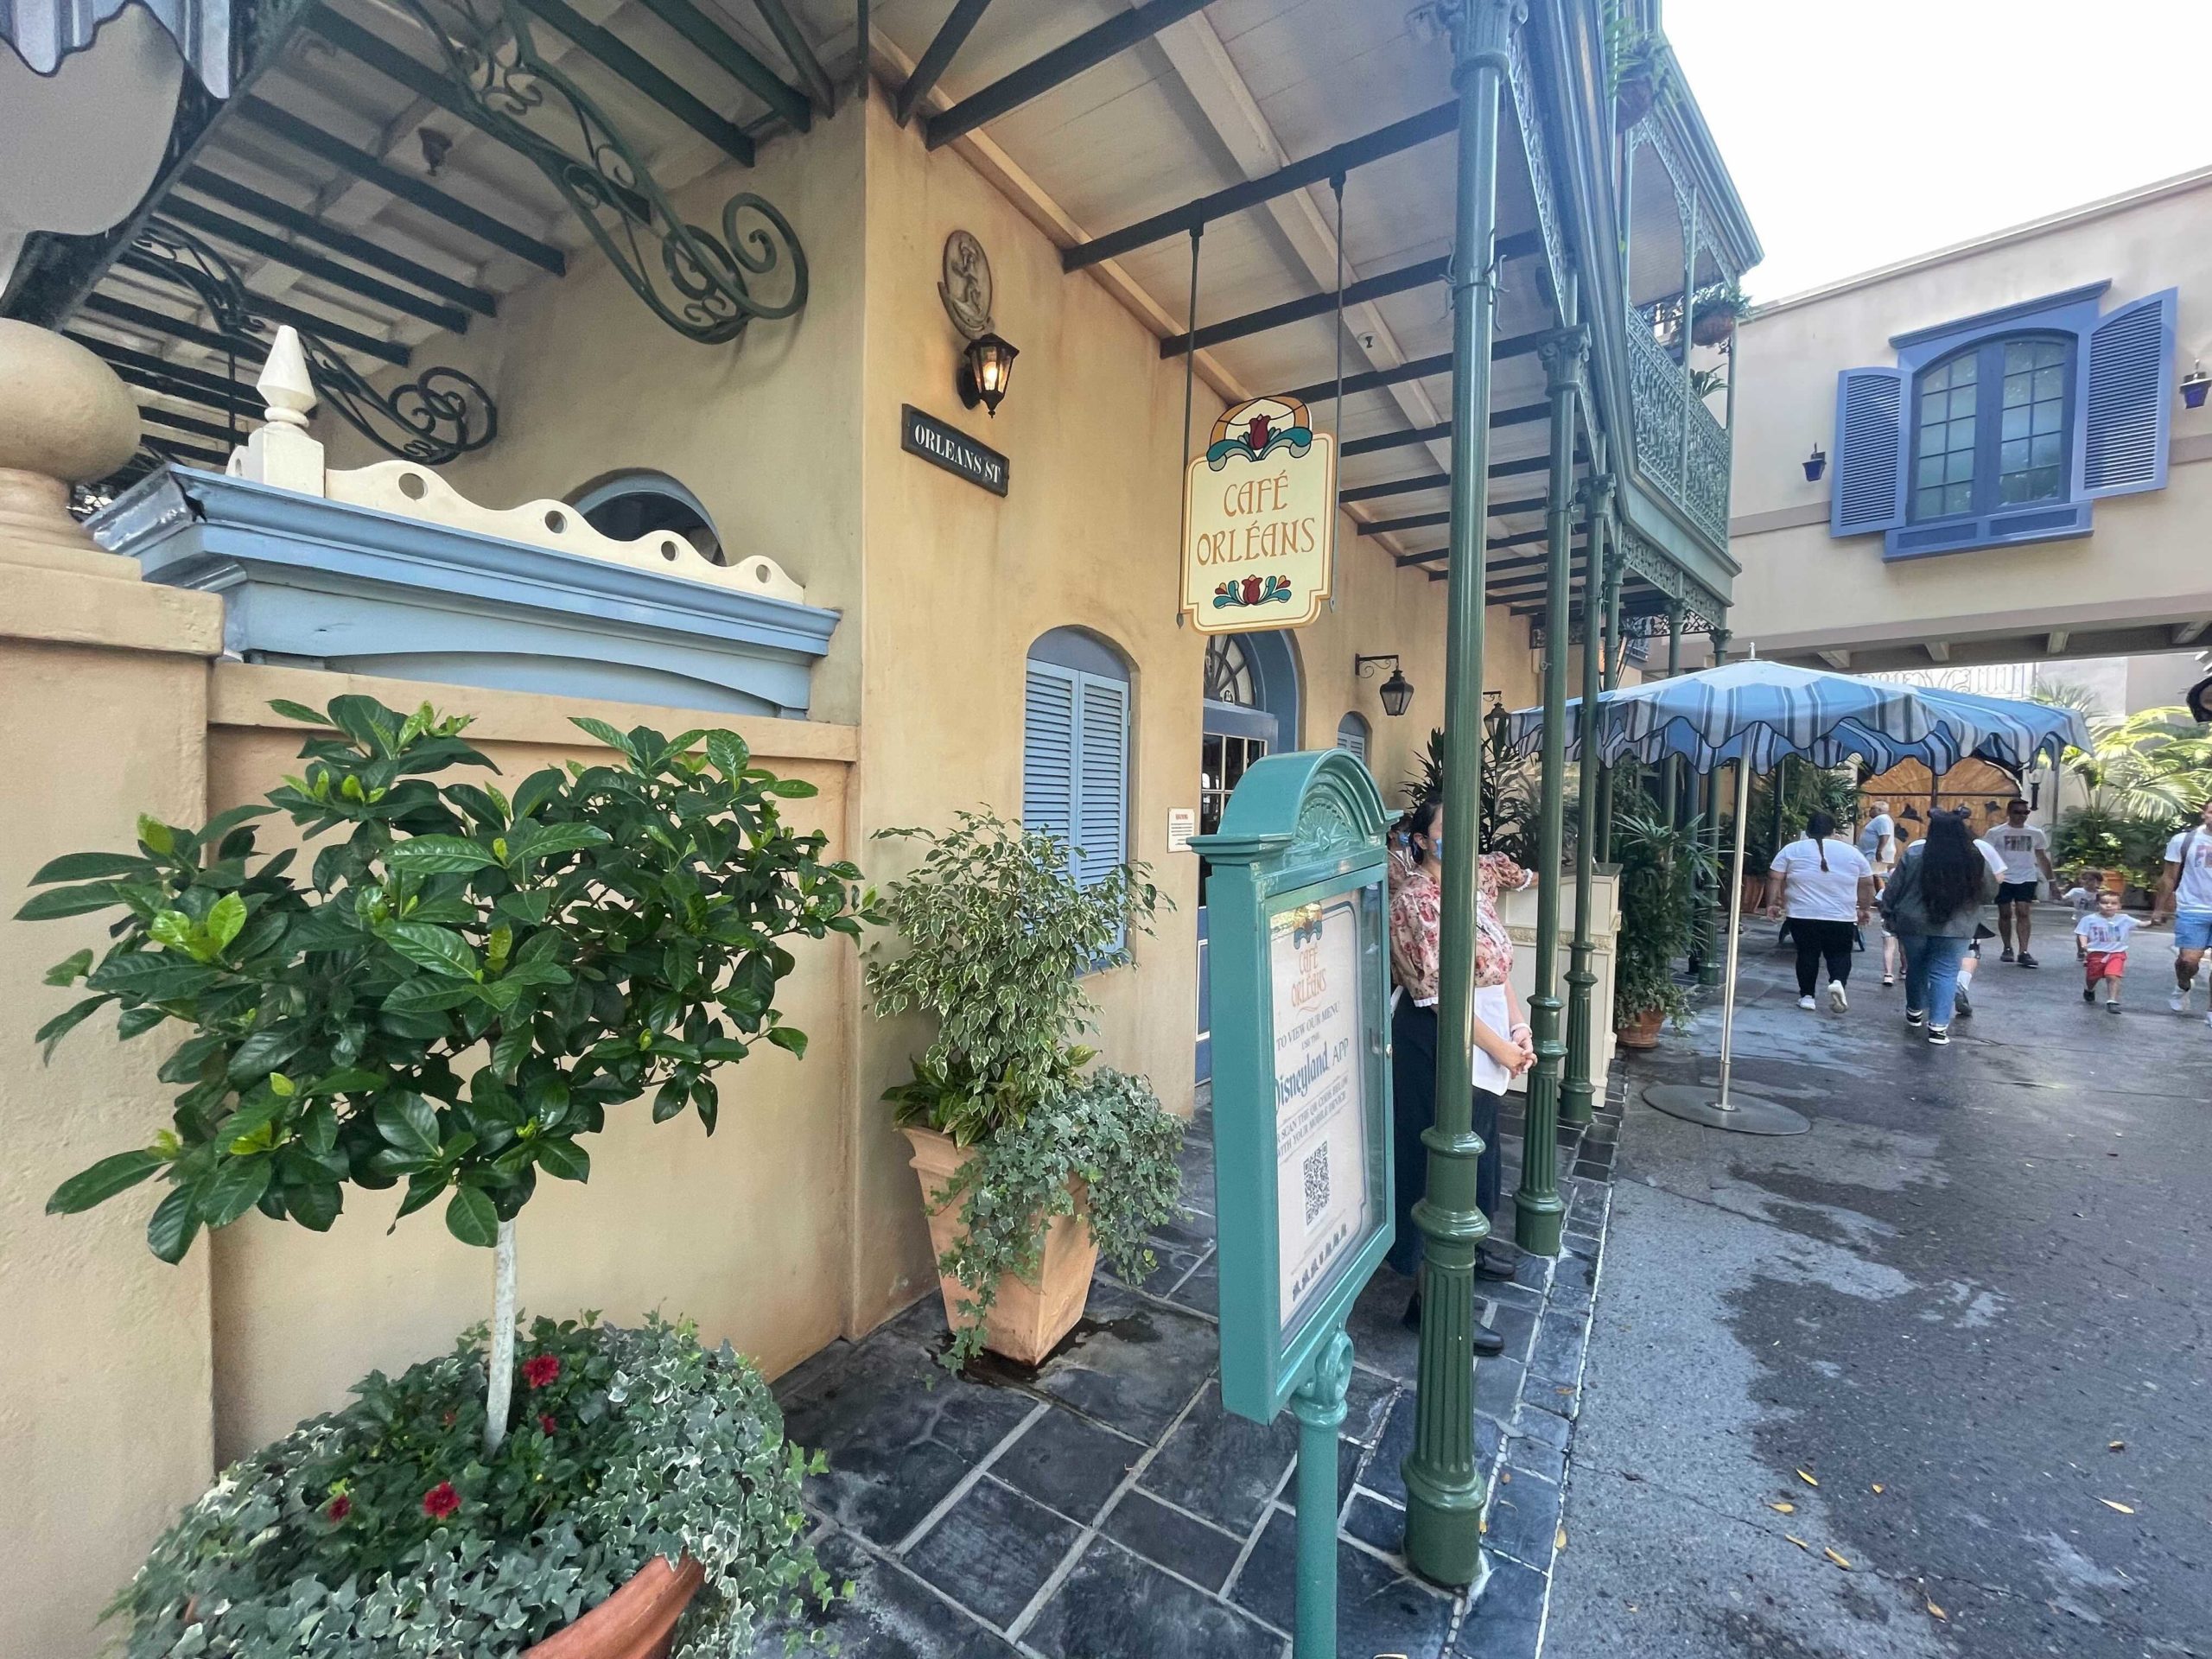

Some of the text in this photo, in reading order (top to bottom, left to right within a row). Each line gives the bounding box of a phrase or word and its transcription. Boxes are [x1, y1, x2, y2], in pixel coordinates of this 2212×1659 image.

[914, 423, 1001, 483] ORLEANS ST
[1224, 469, 1288, 517] CAFÉ
[1197, 518, 1315, 566] ORLÉANS
[1276, 1001, 1340, 1052] TO VIEW OUR MENU
[1332, 1038, 1348, 1066] APP
[1281, 1120, 1296, 1140] SCAN
[1293, 1125, 1308, 1145] YOUR
